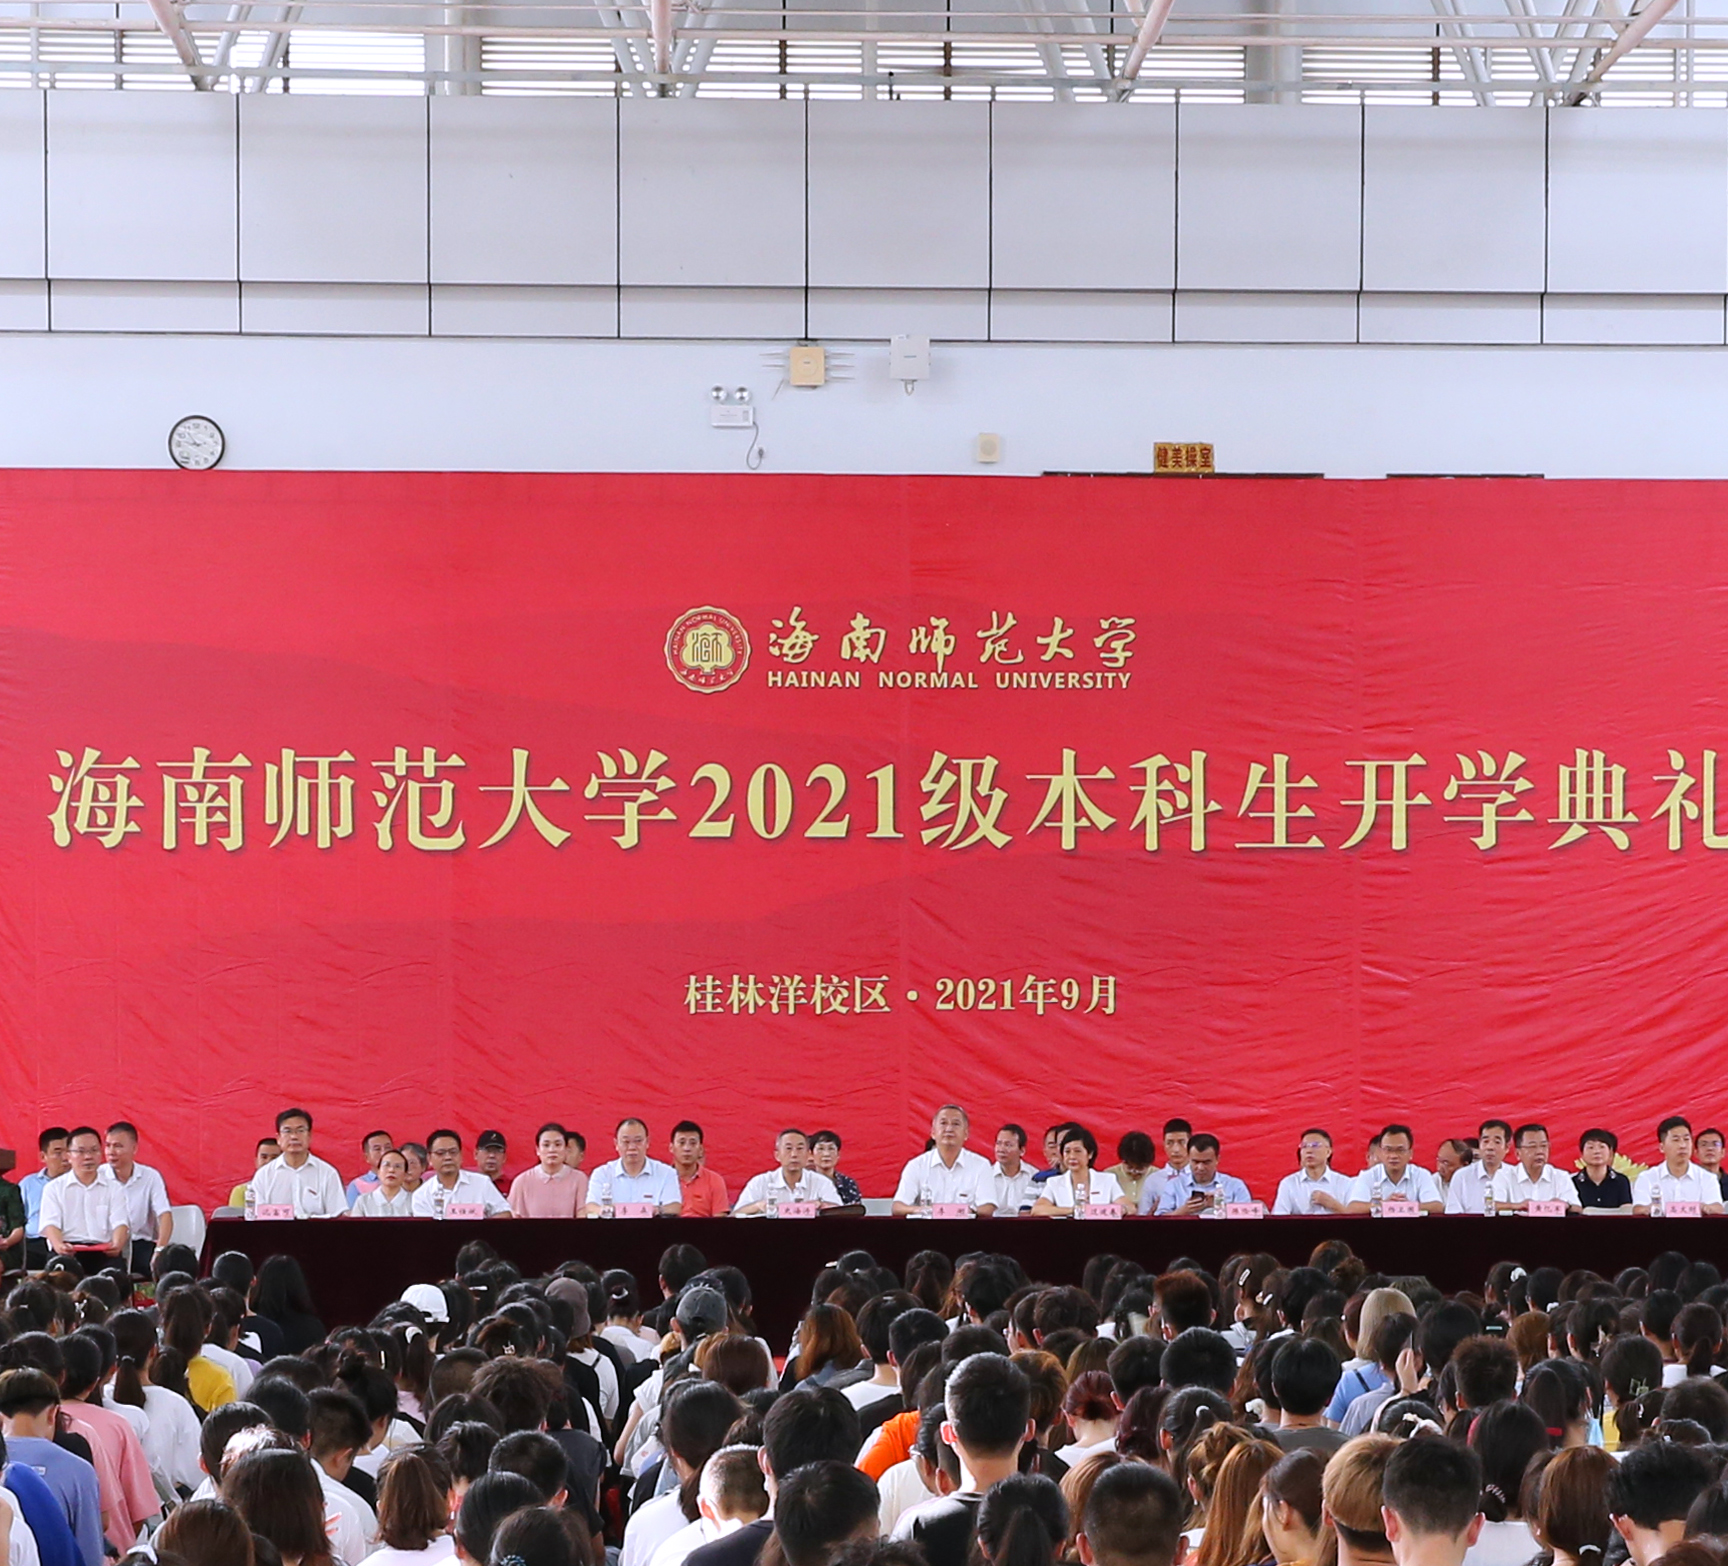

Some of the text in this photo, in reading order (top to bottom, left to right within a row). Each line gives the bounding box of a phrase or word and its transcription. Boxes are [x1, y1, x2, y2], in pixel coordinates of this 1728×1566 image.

[769, 605, 1137, 671] 海南师范大学
[768, 671, 1132, 689] HAINAN NORMAL UNIVERSITY
